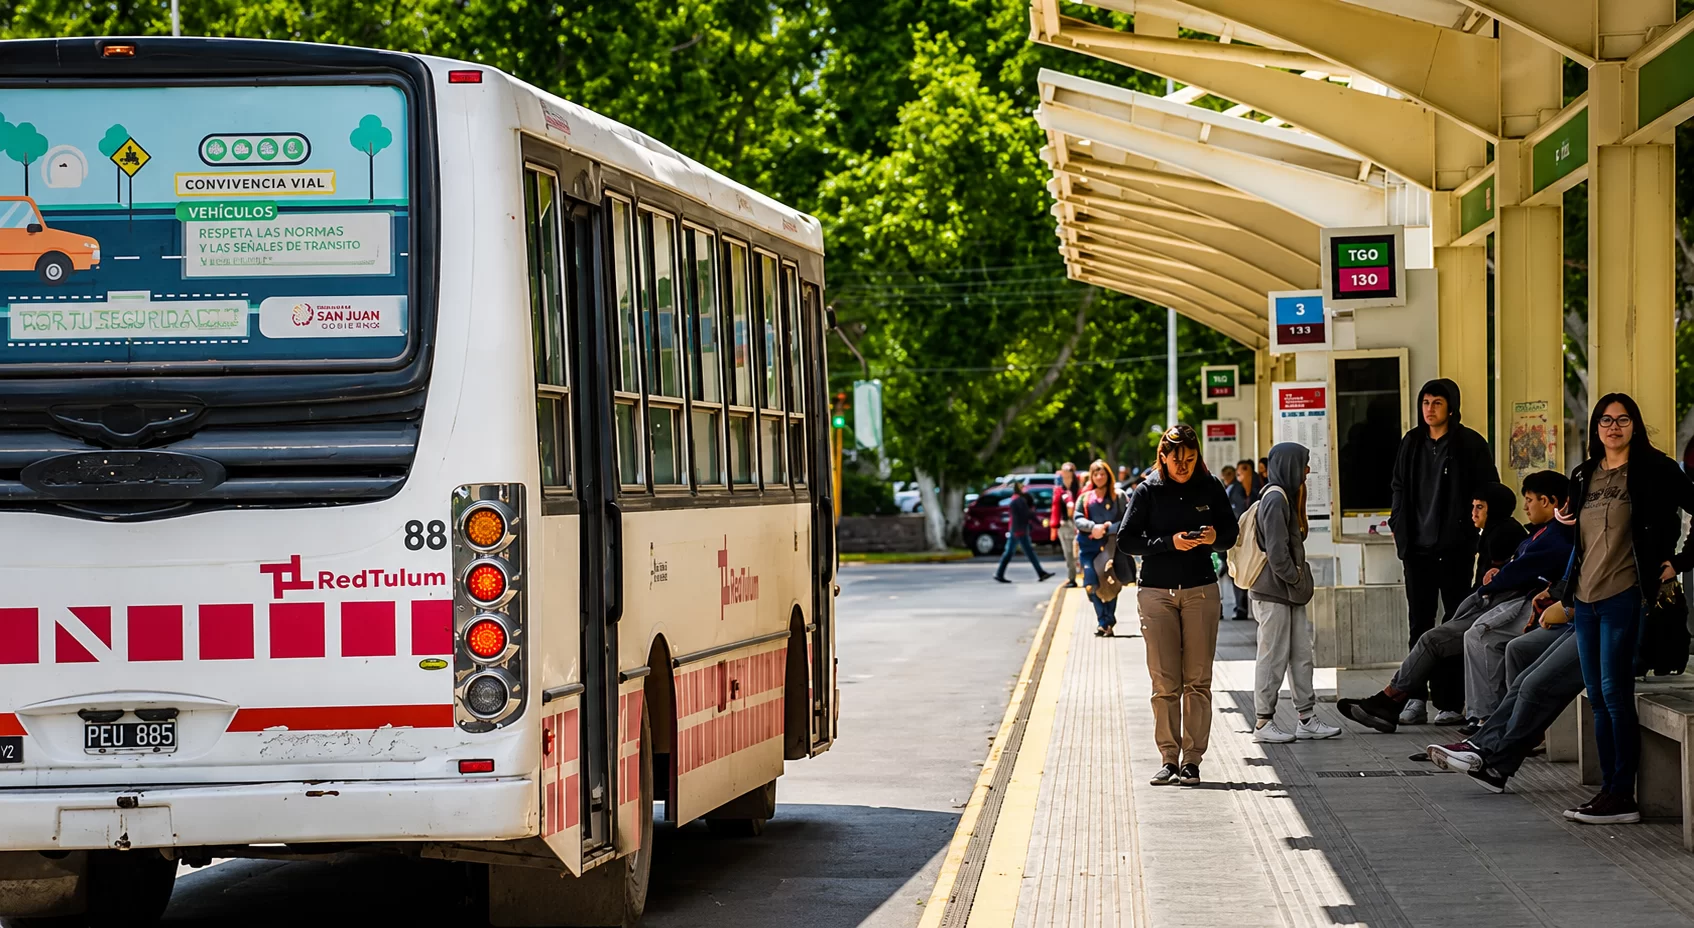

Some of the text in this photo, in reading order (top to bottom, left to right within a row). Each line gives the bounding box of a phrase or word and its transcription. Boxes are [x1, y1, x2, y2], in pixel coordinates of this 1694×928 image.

[185, 177, 325, 190] CONVIVENCIA VIAL
[188, 204, 273, 218] VEHÍCULOS
[200, 226, 344, 238] RESPETA LAS NORMAS
[199, 240, 361, 253] Y LAS SEÑALES DE TRANSITO
[1348, 249, 1379, 261] TGO
[1351, 273, 1378, 286] 130
[317, 311, 380, 321] SAN JUAN
[1295, 303, 1305, 316] 3
[1289, 326, 1311, 334] 133
[404, 519, 448, 551] 88
[318, 568, 446, 589] RedTulum
[87, 724, 174, 747] PEU 885
